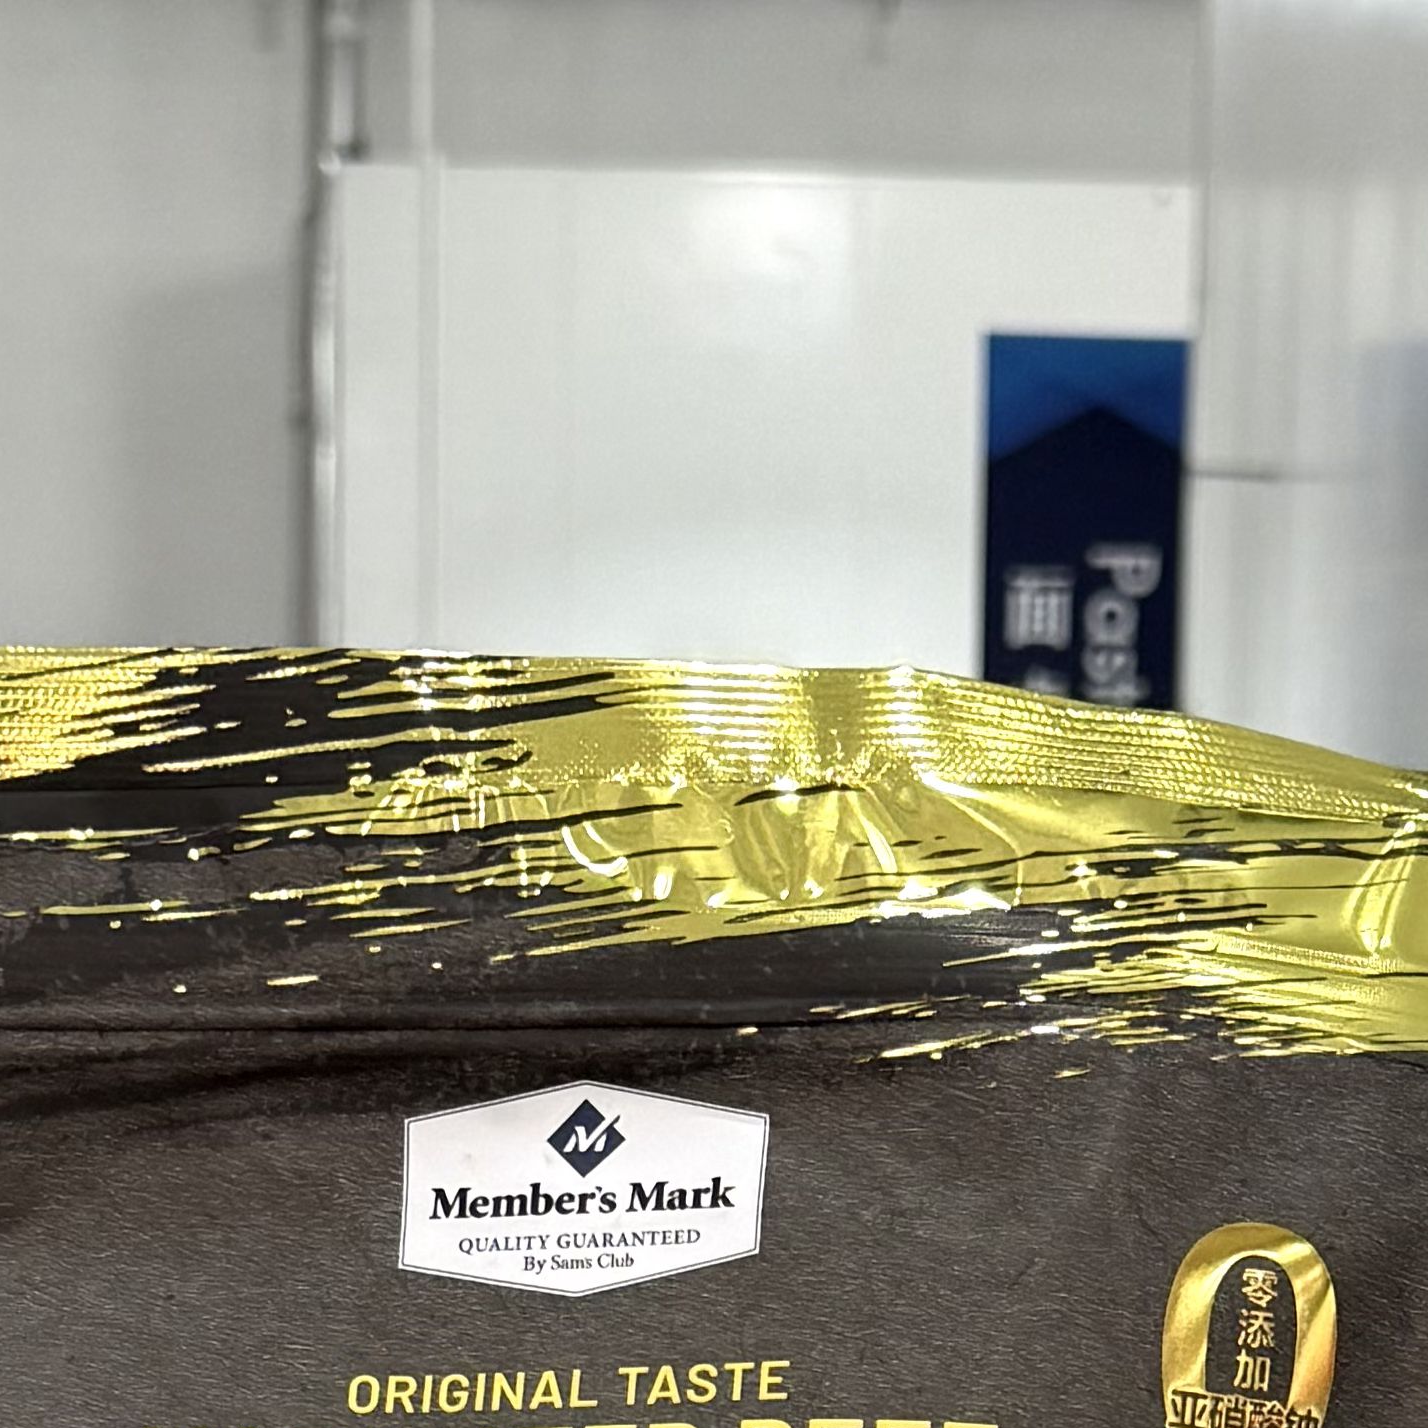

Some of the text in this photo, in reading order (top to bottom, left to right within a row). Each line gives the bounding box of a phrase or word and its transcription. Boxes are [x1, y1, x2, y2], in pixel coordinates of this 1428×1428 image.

[429, 1176, 737, 1219] Member's Mark
[458, 1228, 701, 1255] QUALITY GUARANTEED
[523, 1255, 547, 1275] By
[597, 1252, 635, 1268] Club
[1232, 1267, 1278, 1392] 零添加
[347, 1360, 791, 1416] ORIGINAL TASTE
